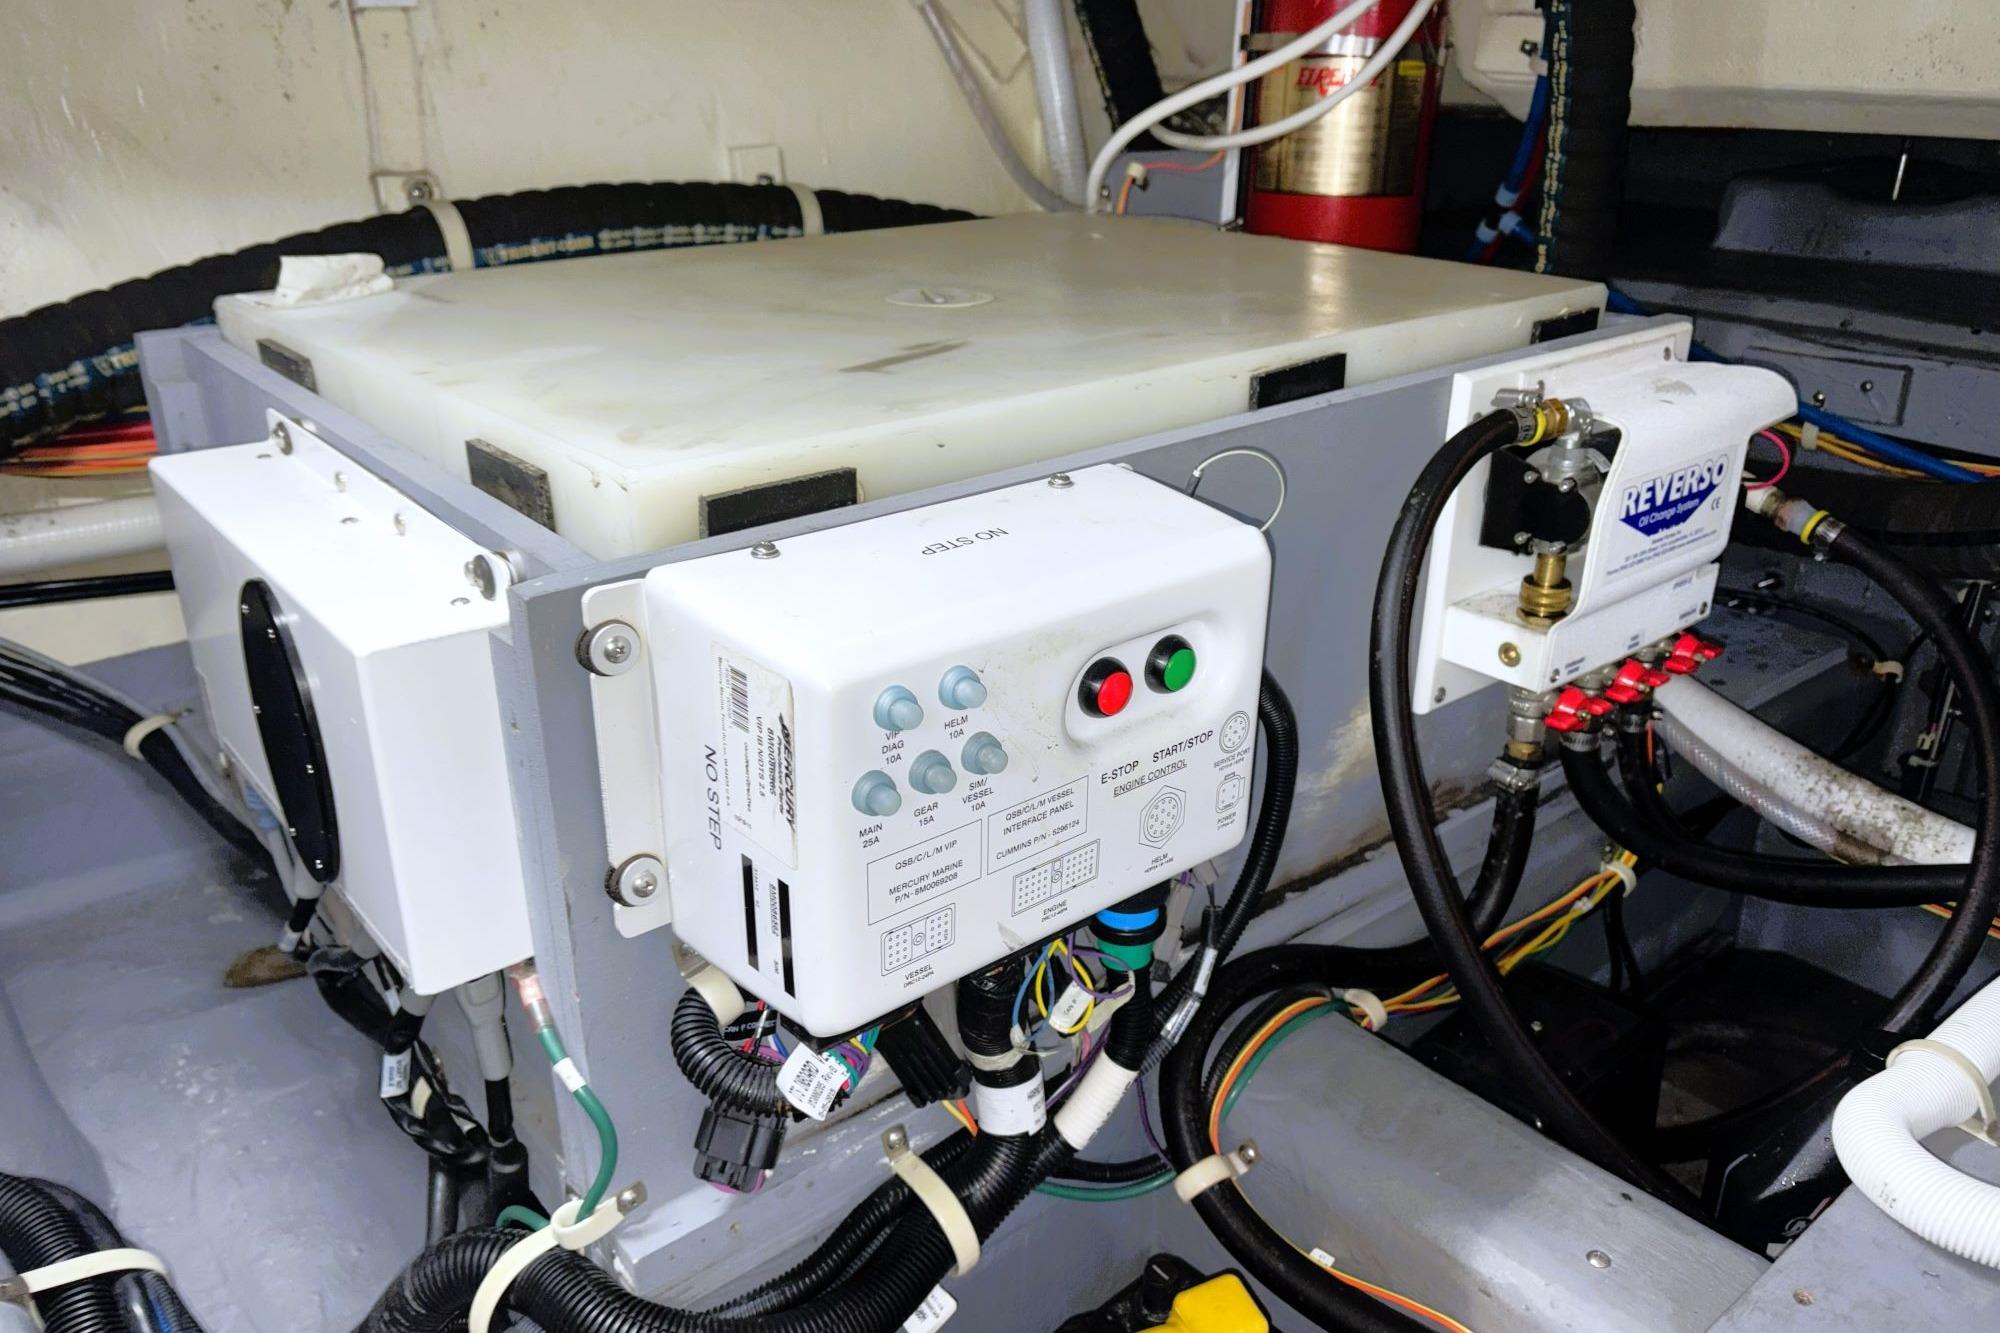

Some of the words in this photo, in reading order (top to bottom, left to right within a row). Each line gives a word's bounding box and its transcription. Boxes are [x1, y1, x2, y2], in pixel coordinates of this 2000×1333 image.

[1621, 455, 1728, 519] REVERSO
[1639, 515, 1649, 527] Oil
[1650, 507, 1676, 523] Change
[975, 528, 1009, 540] NO
[921, 537, 974, 555] STEP
[944, 715, 968, 730] HELM
[885, 730, 902, 741] VIP
[949, 729, 964, 740] 10A
[881, 740, 905, 754] DIAG
[1152, 730, 1214, 763] START/STOP
[704, 744, 718, 783] NO
[885, 753, 902, 765] 10A
[1101, 760, 1139, 784] E-STOP
[1113, 775, 1146, 797] ENGINE
[1148, 759, 1188, 781] CONTROL
[969, 778, 988, 791] SIM/
[962, 787, 994, 804] VESSEL
[913, 802, 939, 817] GEAR
[971, 801, 986, 812] 10A
[1005, 799, 1046, 821] QSB/C/L/M
[1047, 788, 1074, 804] VESSEL
[707, 788, 722, 850] STEP
[919, 815, 935, 827] 15A
[1003, 811, 1048, 835] INTERFACE
[1049, 800, 1074, 816] PANEL
[859, 823, 883, 838] MAIN
[862, 836, 880, 848] 25A
[996, 839, 1032, 860] CUMMINS
[1033, 832, 1047, 844] P/N
[895, 845, 943, 871] QSB/C/L/M
[944, 839, 958, 851] VIP
[1151, 853, 1168, 864] HELM
[889, 872, 931, 896] MERCURY
[932, 859, 964, 878] MARINE
[1043, 900, 1067, 915] ENGINE
[904, 964, 933, 981] VESSEL
